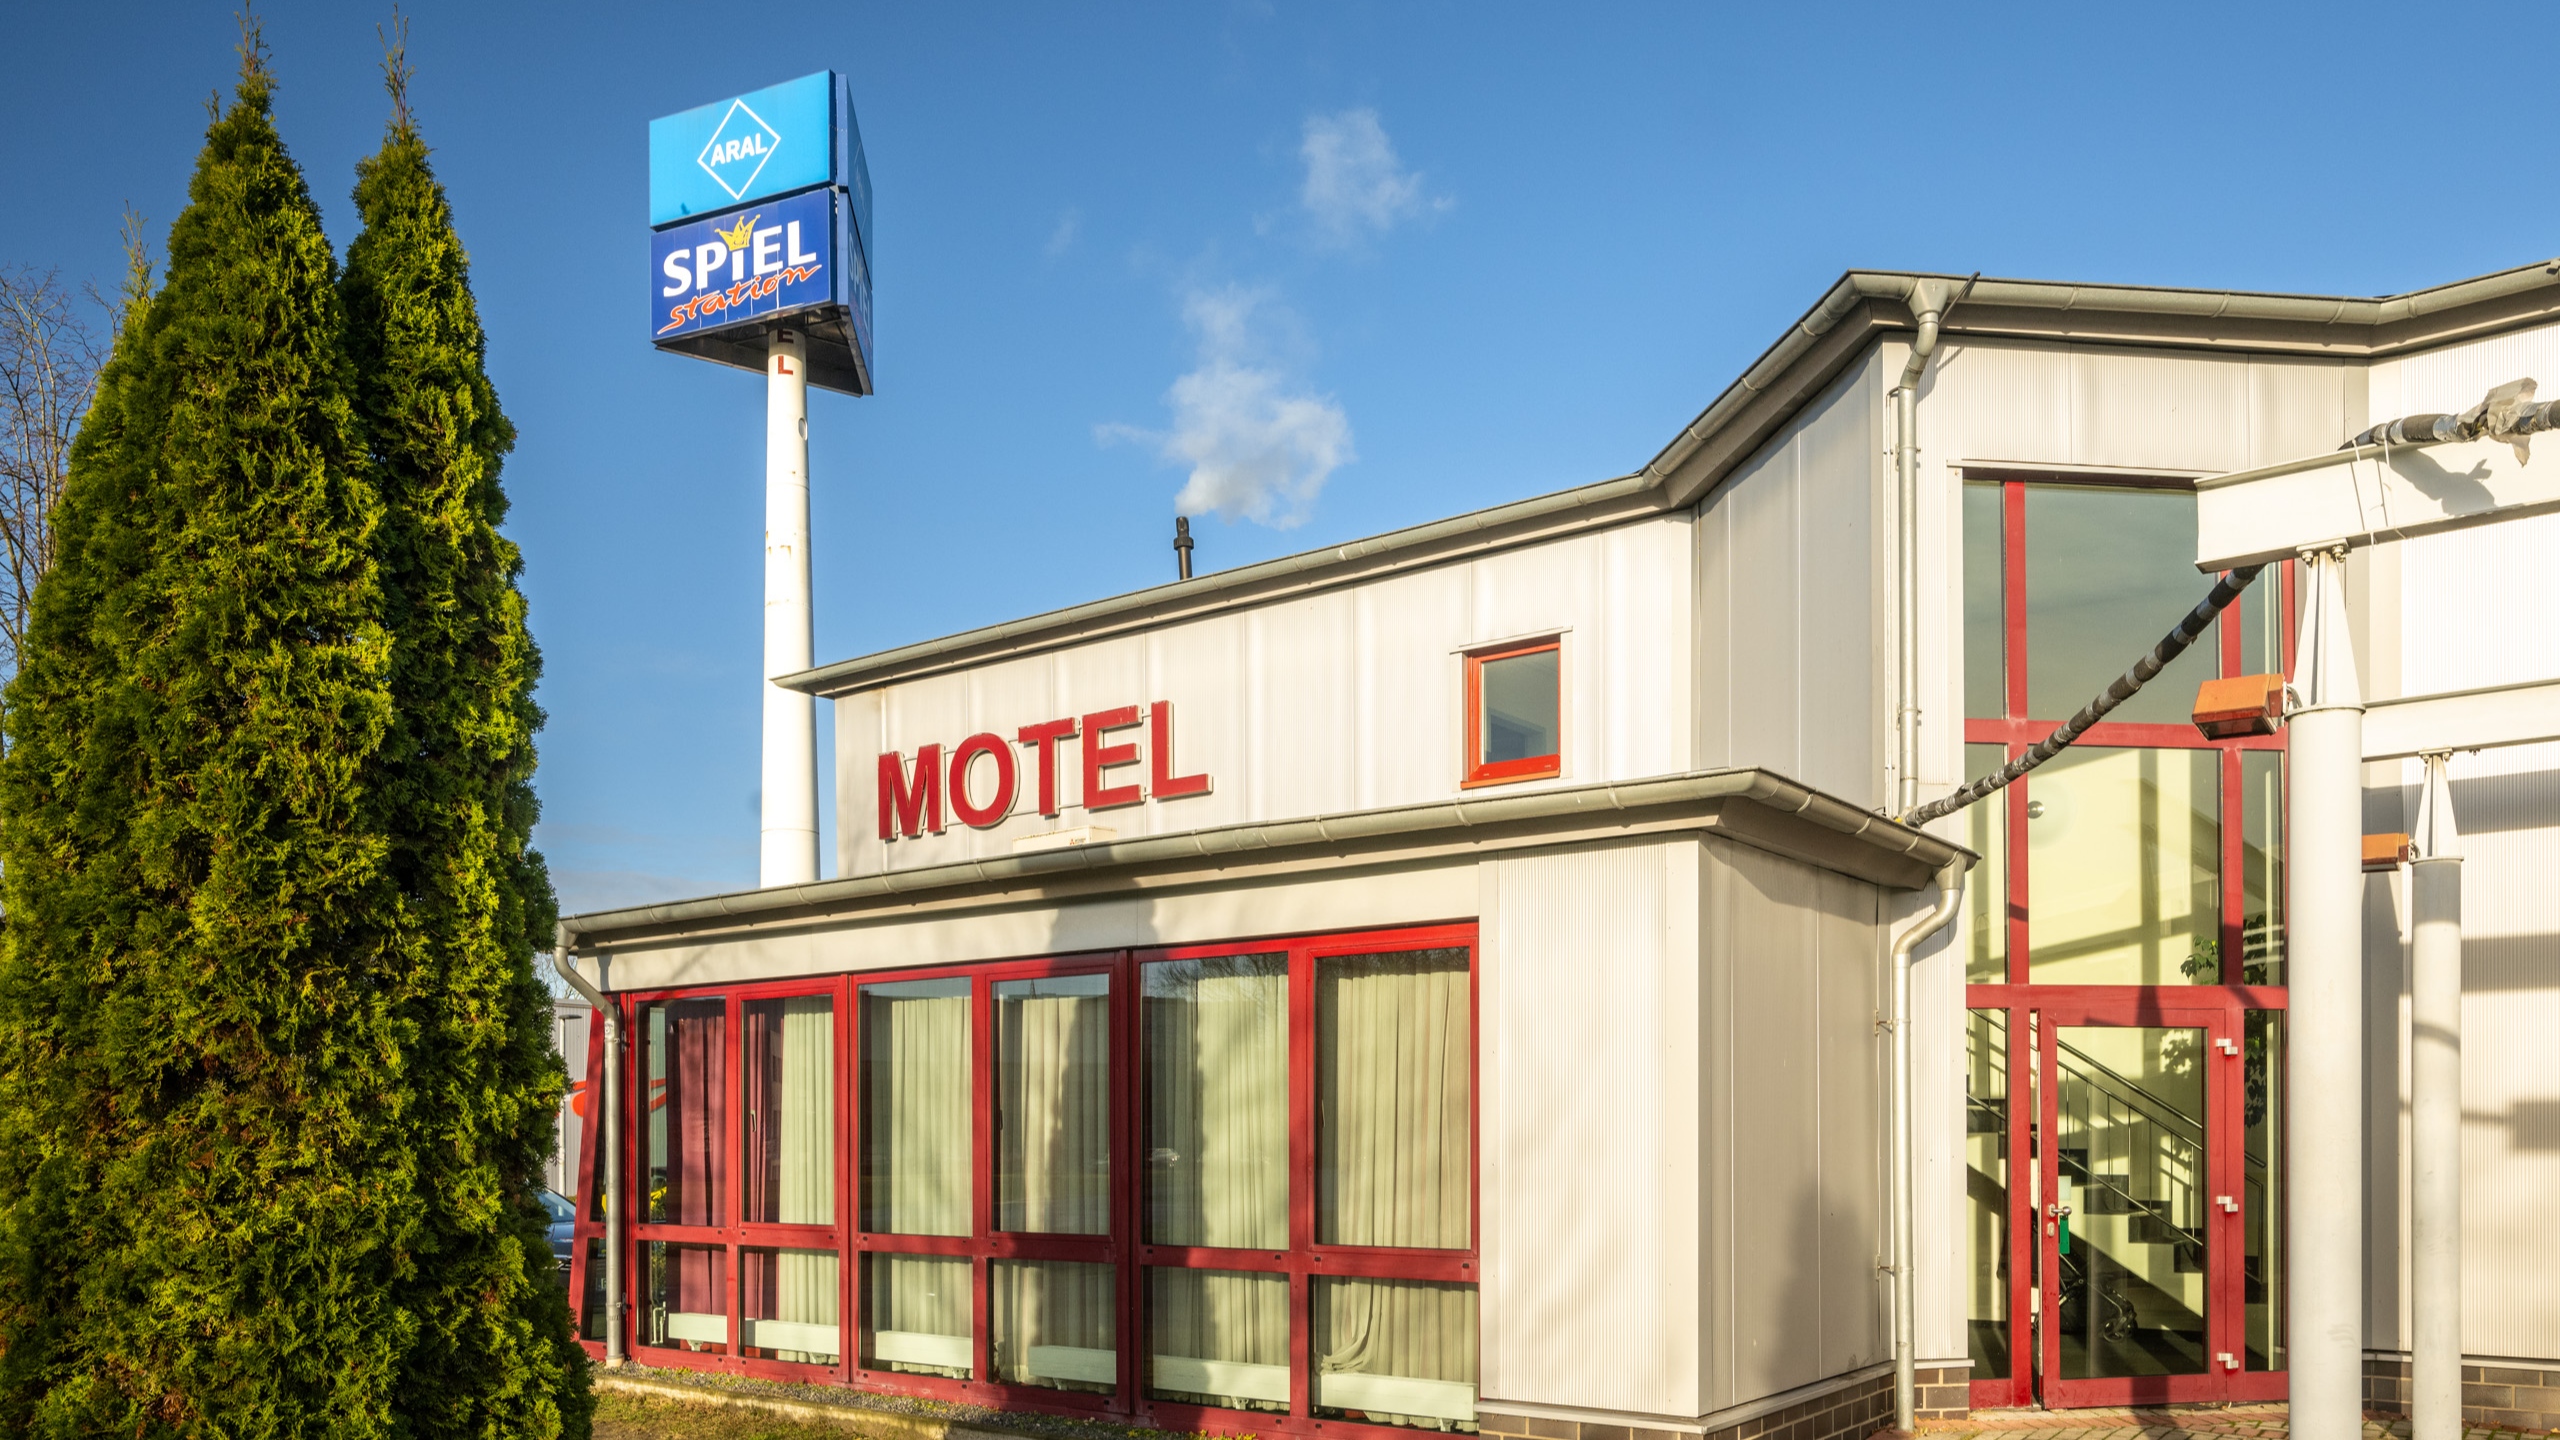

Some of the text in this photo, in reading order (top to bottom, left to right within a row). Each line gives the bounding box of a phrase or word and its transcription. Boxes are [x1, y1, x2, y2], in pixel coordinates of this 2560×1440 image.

[710, 132, 768, 167] ARAL
[657, 264, 823, 335] station
[877, 700, 1213, 841] MOTEL
